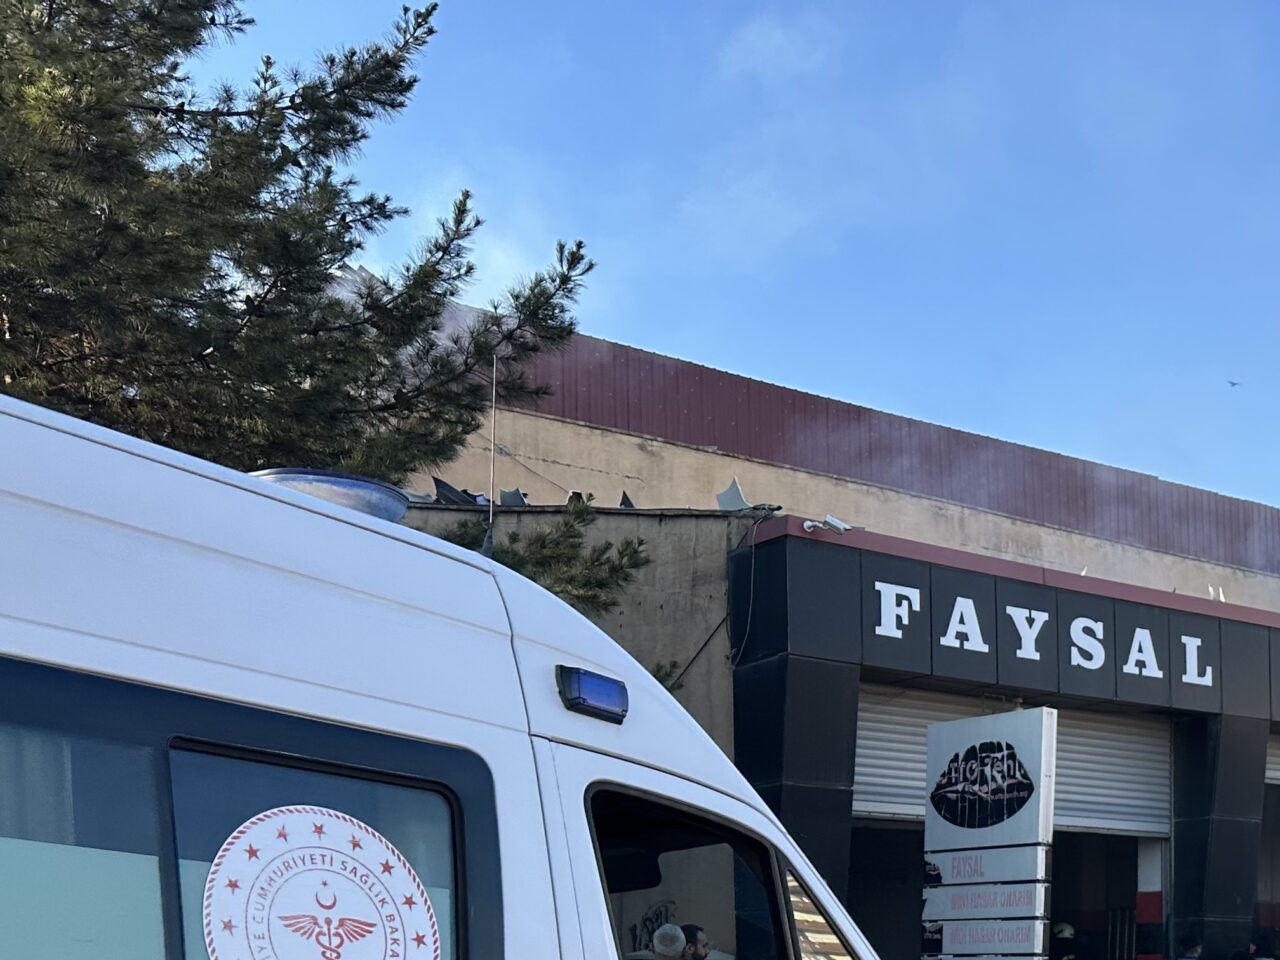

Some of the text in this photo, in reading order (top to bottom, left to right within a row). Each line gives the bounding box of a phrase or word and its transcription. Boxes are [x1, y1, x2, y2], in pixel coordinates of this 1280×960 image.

[874, 580, 1213, 687] FAYSAL
[252, 852, 336, 925] CUMHURİYETİ
[339, 859, 390, 910] SAĞLIK
[951, 855, 985, 879] FAYSAL
